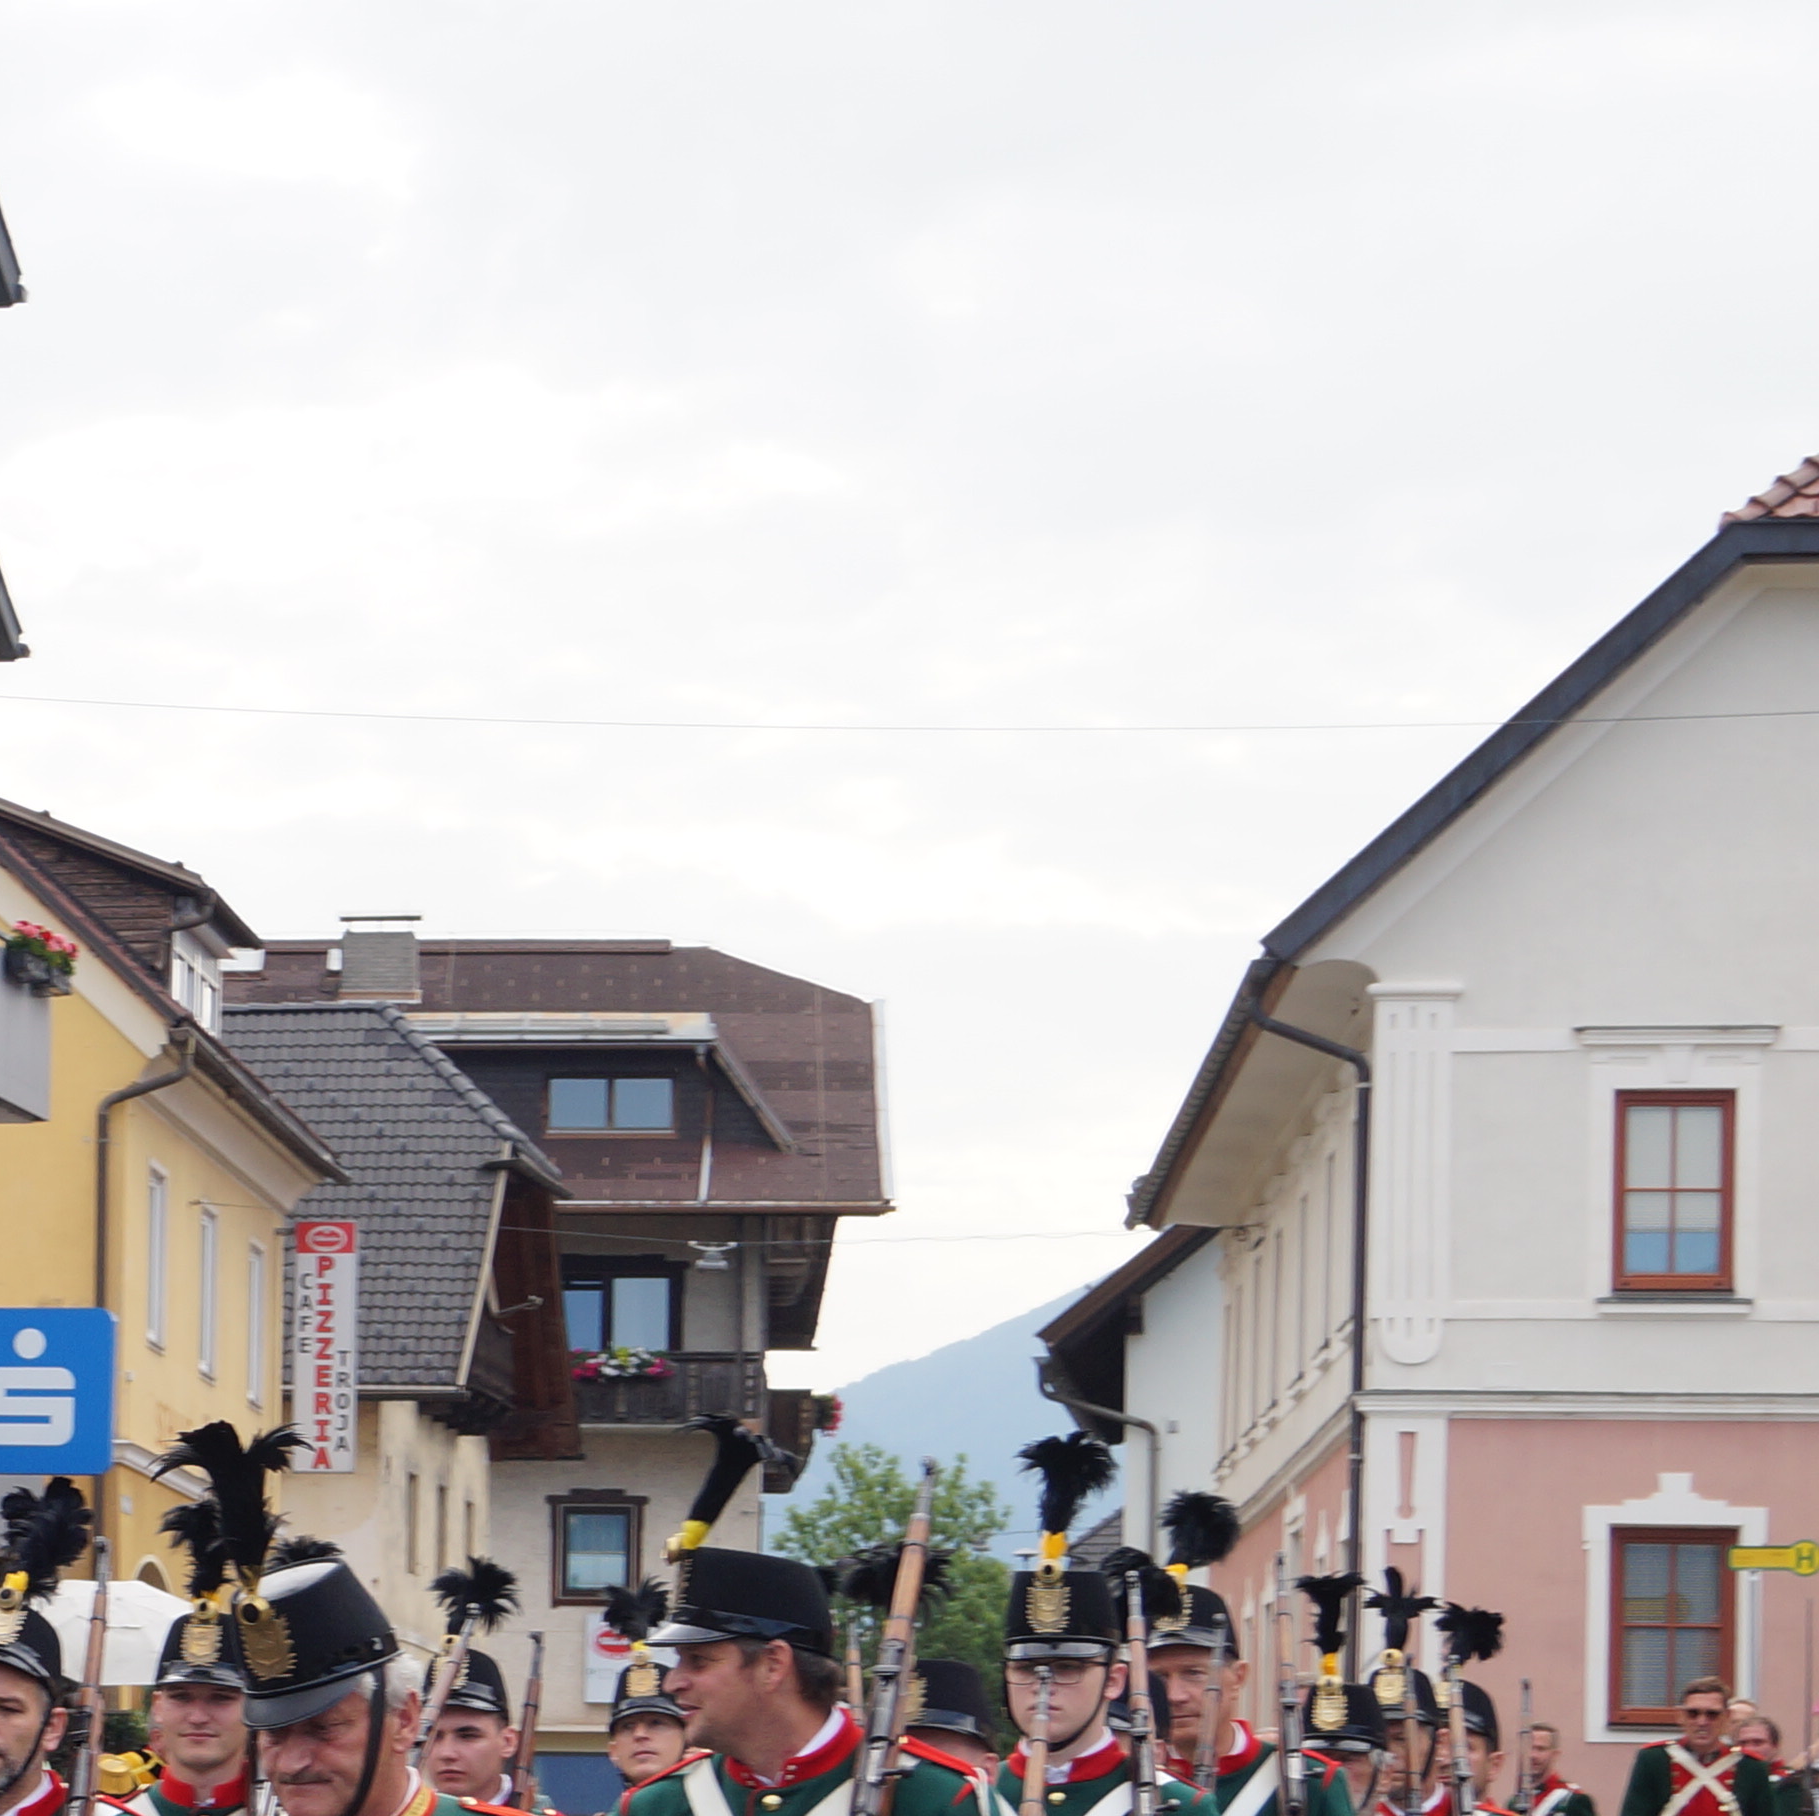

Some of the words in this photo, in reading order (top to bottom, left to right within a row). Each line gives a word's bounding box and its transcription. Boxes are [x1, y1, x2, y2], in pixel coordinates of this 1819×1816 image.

[298, 1273, 313, 1353] CAFE
[311, 1256, 335, 1469] PIZZERIA
[333, 1350, 352, 1452] TROJA
[1796, 1547, 1814, 1568] H
